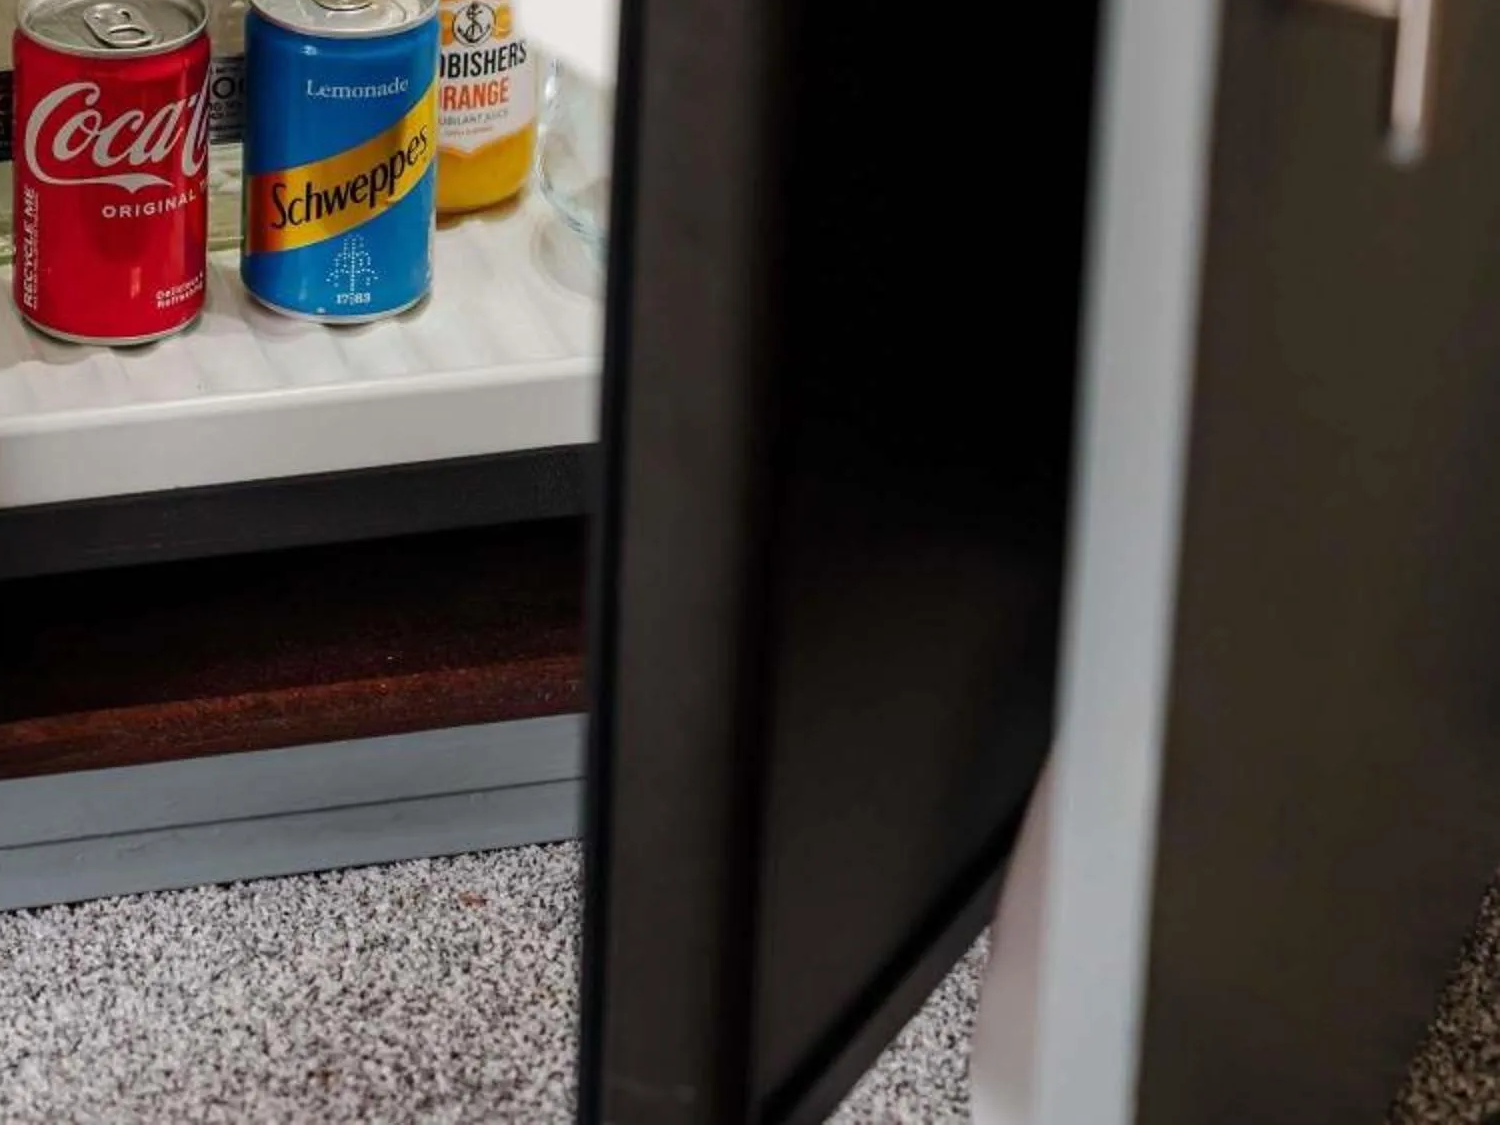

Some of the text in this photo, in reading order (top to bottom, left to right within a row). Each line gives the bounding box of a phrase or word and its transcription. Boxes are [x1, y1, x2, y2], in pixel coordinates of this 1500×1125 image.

[307, 76, 409, 99] Lemonade
[102, 189, 197, 218] ORIGINAL
[271, 125, 428, 229] Schweppes
[23, 184, 35, 308] RECYCLE ME
